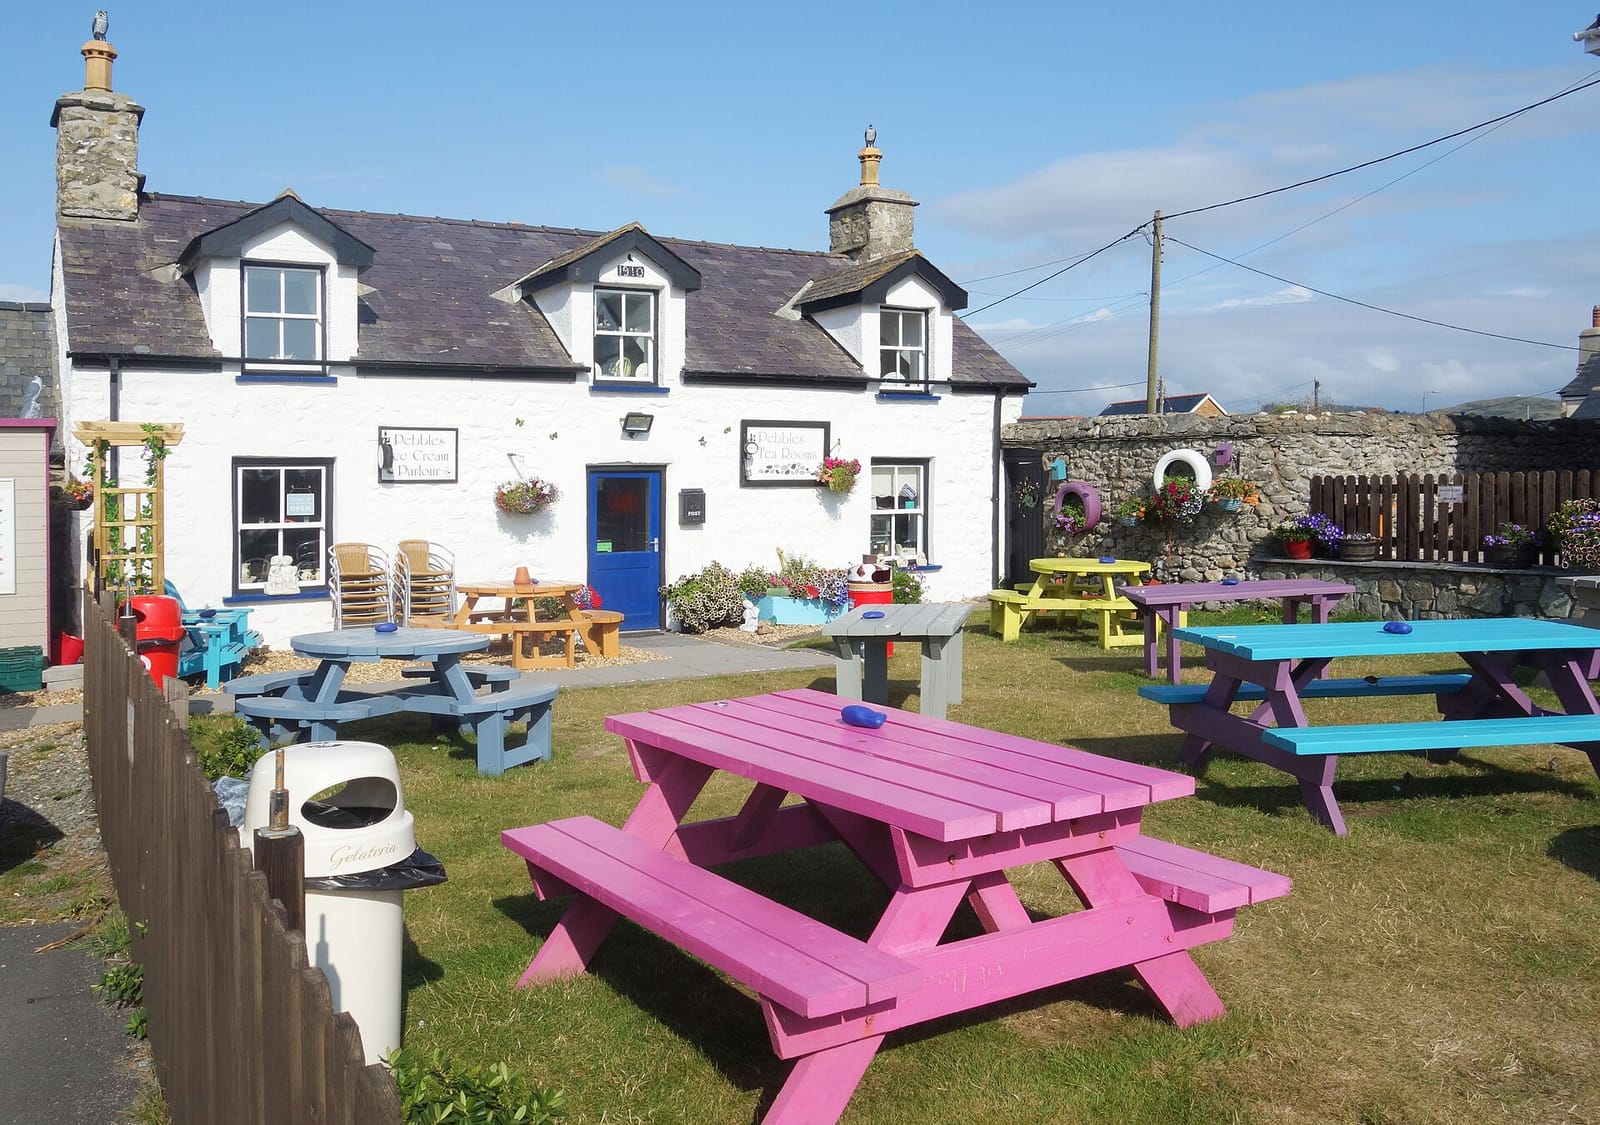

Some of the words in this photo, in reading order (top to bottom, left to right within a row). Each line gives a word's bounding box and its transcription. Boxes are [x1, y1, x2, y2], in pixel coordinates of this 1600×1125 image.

[394, 433, 445, 446] Pebbles
[758, 431, 805, 444] Pebbles
[412, 450, 449, 462] Cream
[759, 447, 777, 459] Tea
[781, 447, 818, 460] Rooms
[398, 464, 440, 477] Parlour
[329, 844, 397, 870] Gelateria
